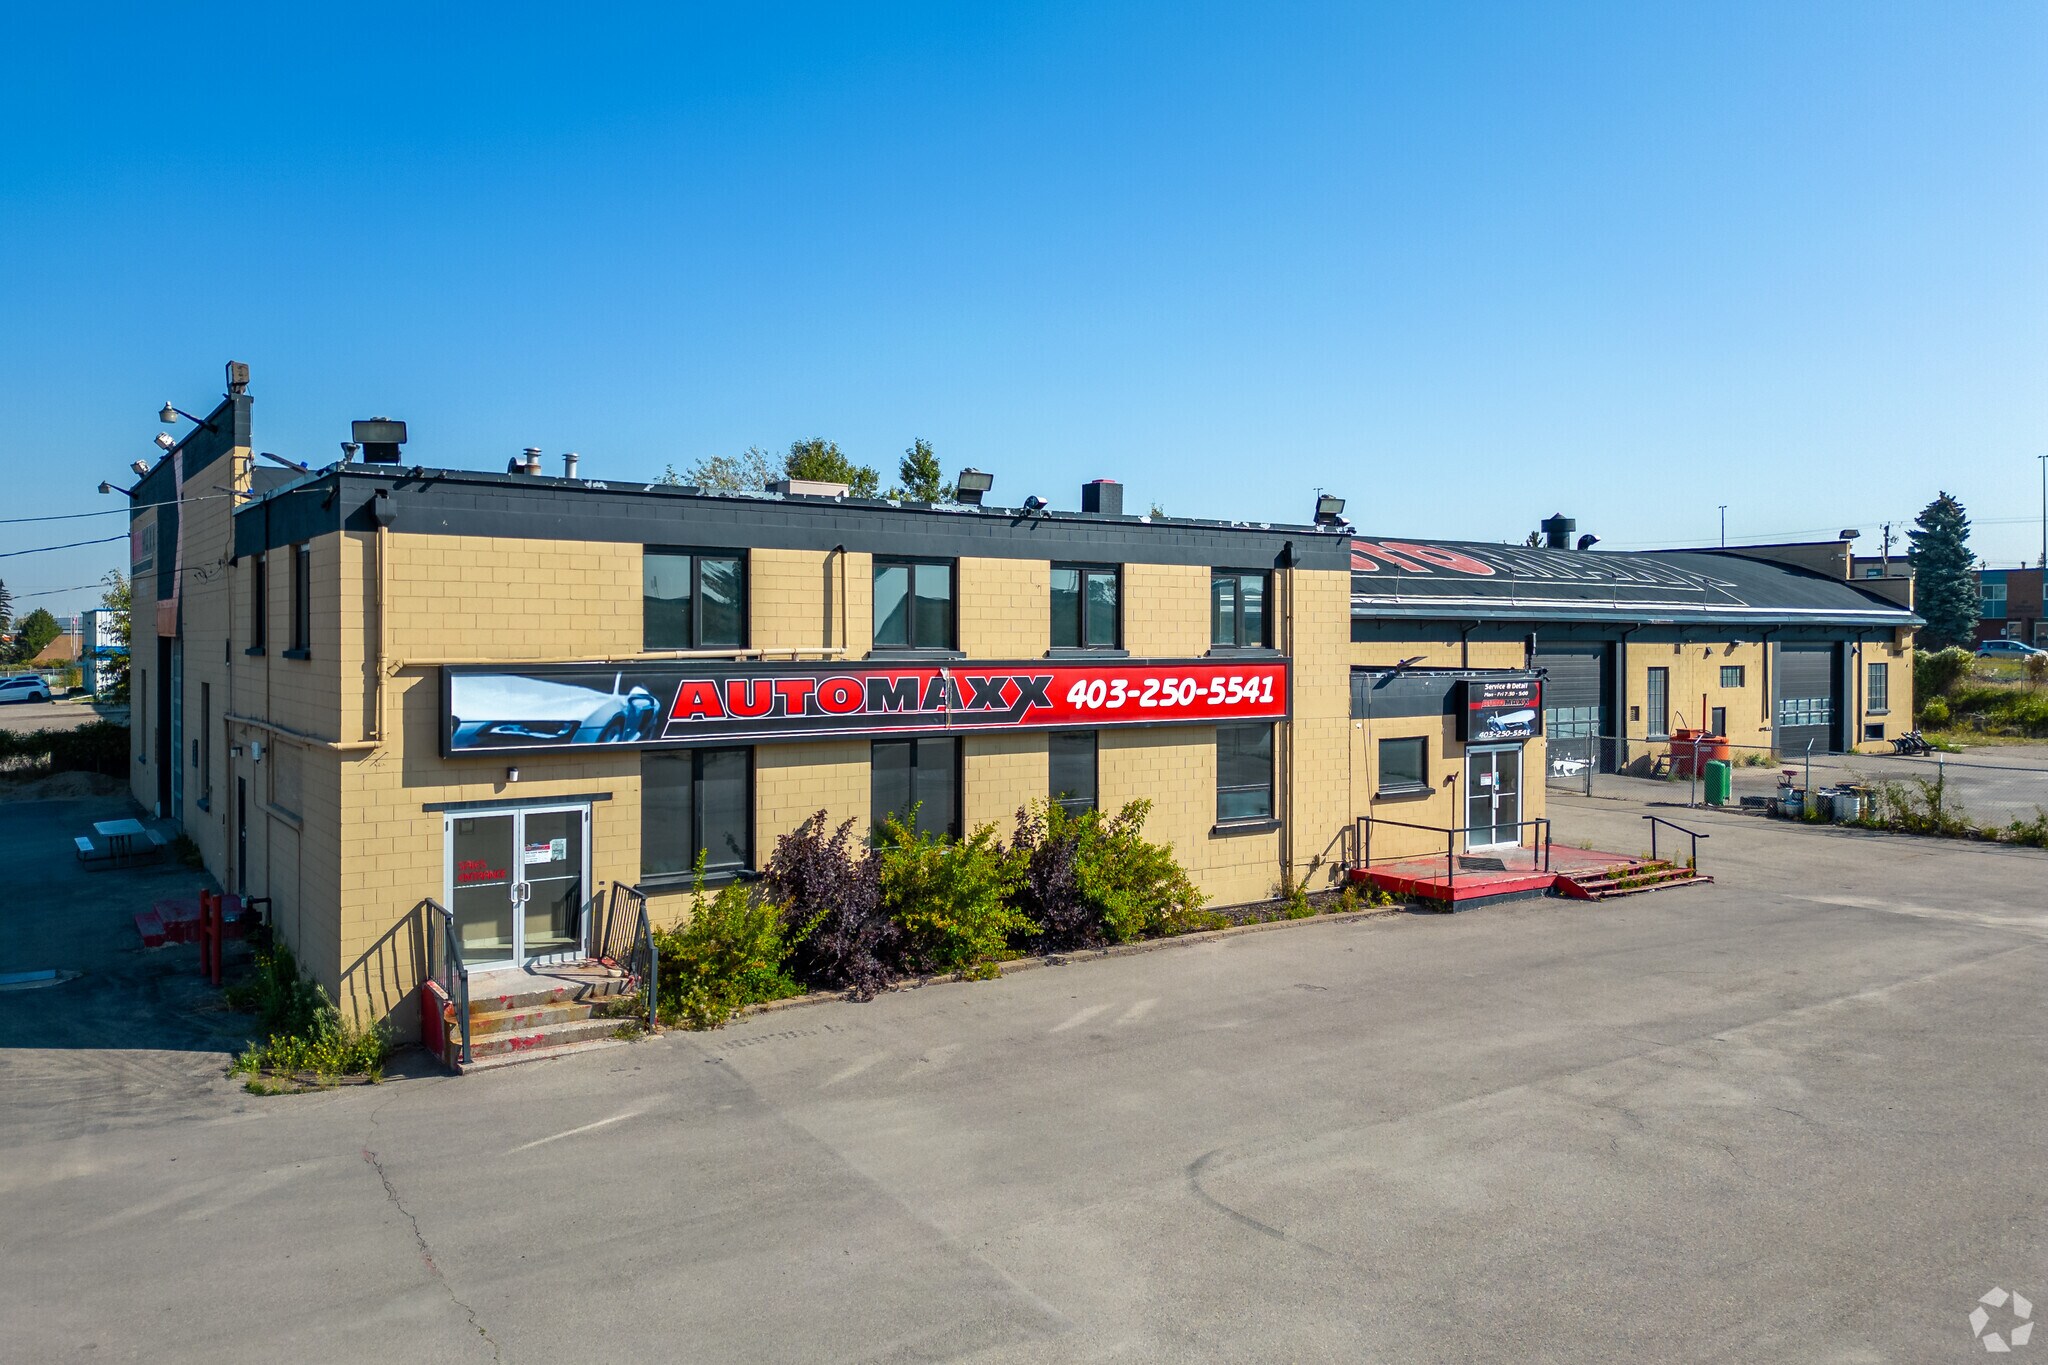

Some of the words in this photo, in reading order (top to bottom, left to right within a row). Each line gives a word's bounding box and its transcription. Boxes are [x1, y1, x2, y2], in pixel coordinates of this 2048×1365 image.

[667, 675, 1054, 723] AUTOMAXX
[1066, 676, 1274, 709] 403-250-5541
[1479, 729, 1530, 738] 403-250-5541
